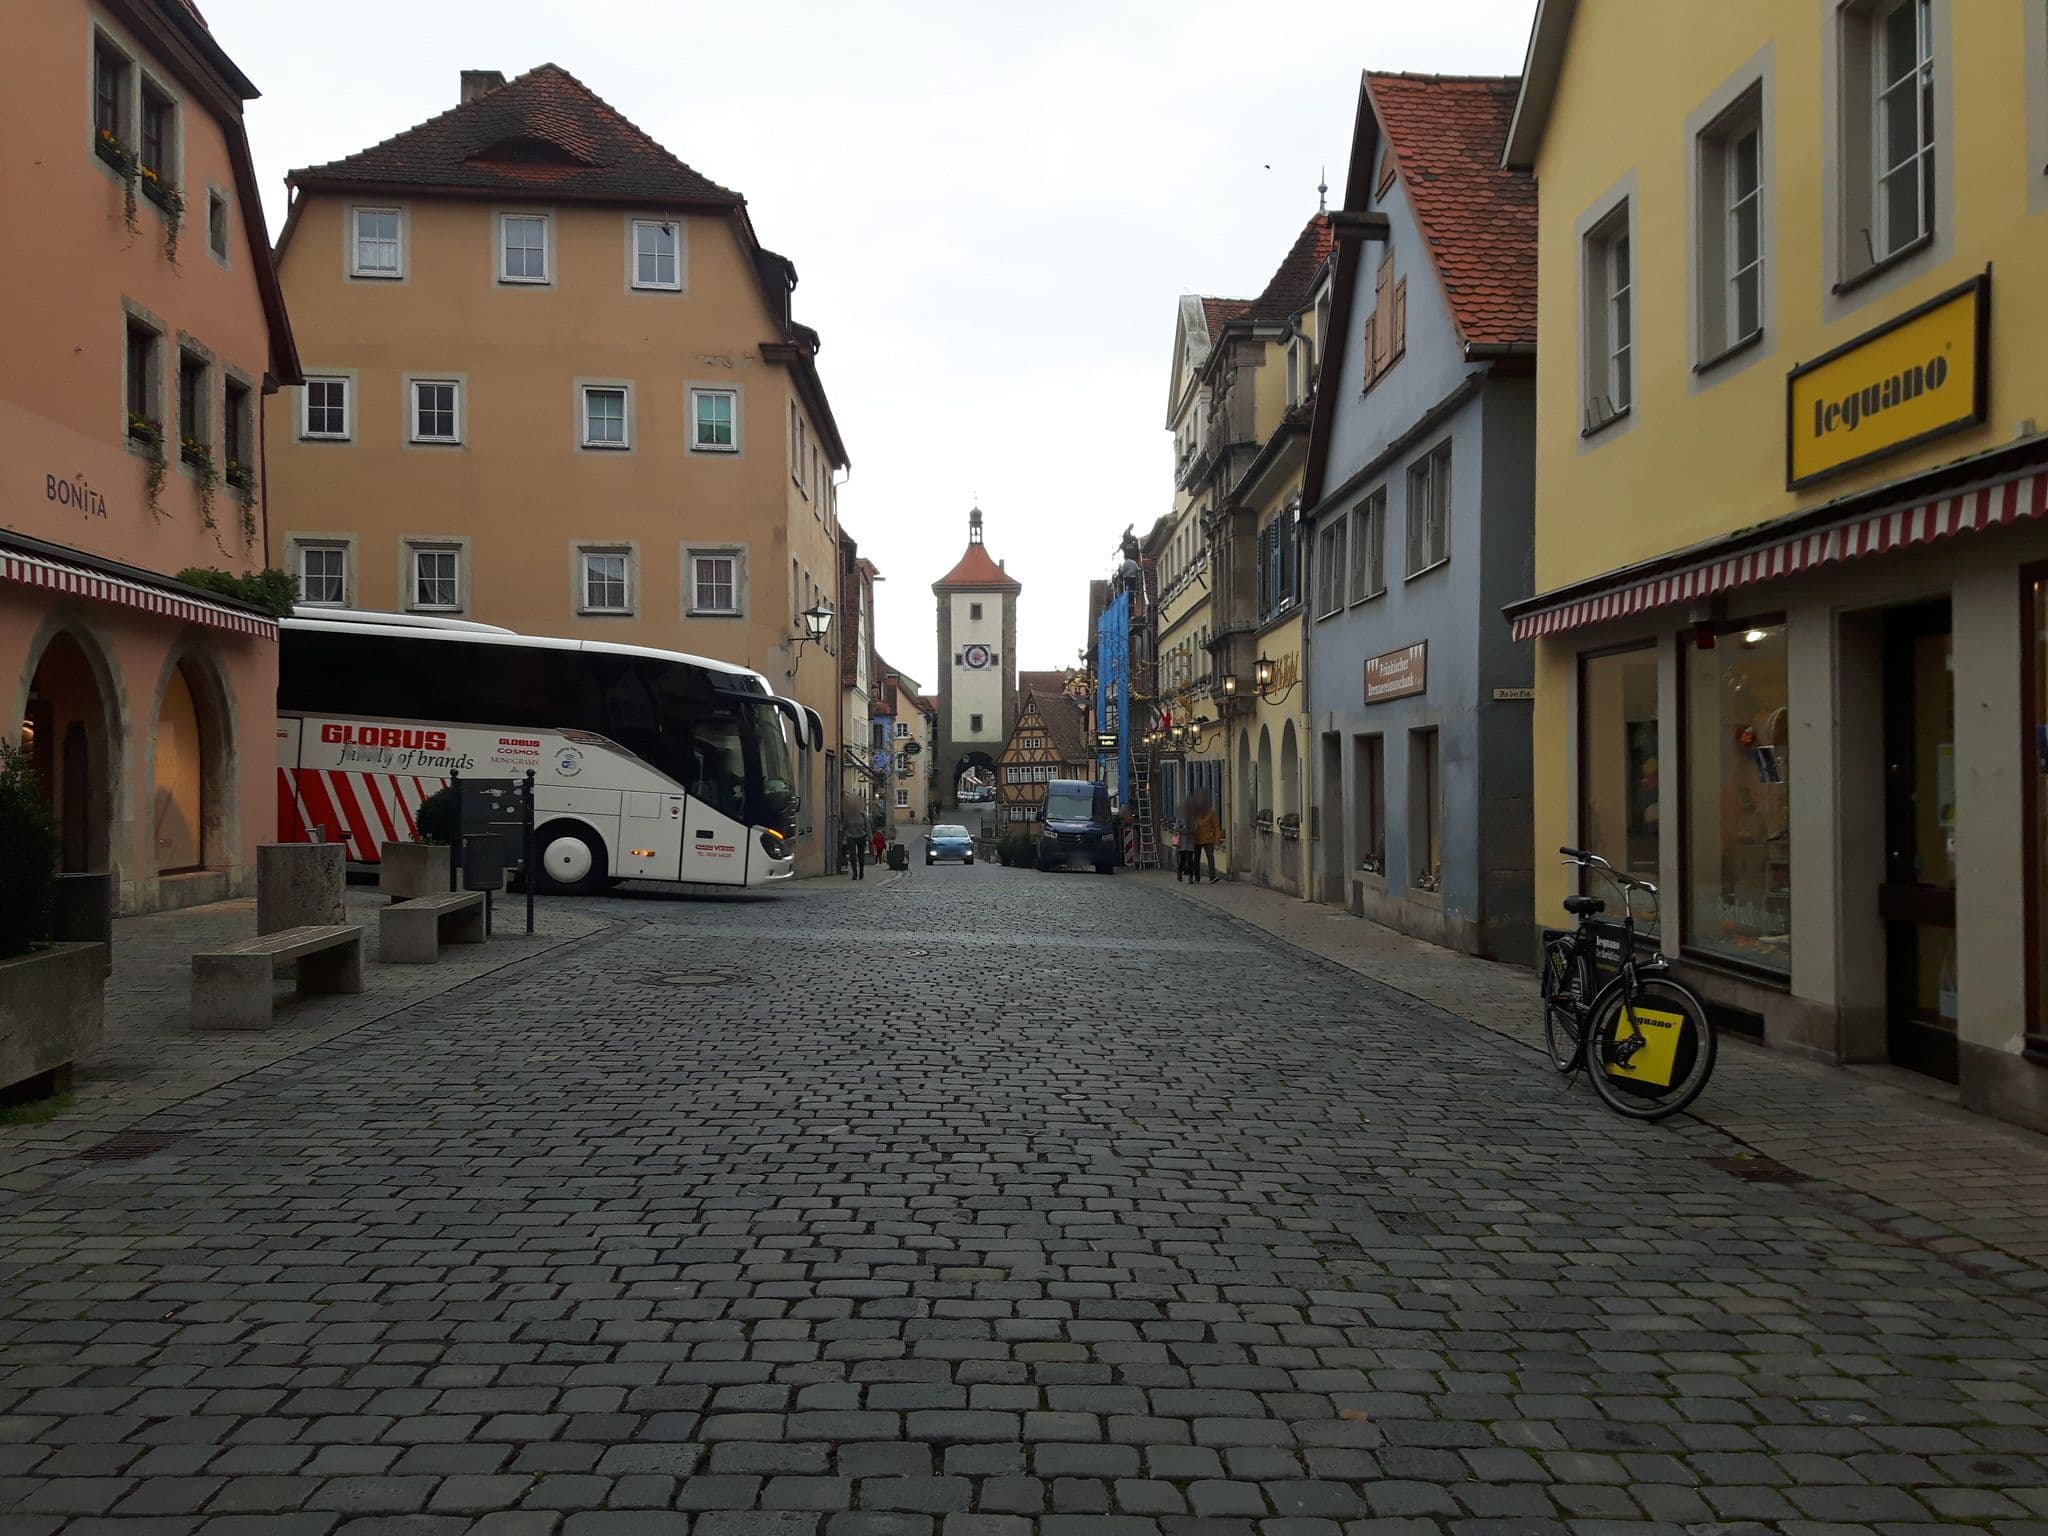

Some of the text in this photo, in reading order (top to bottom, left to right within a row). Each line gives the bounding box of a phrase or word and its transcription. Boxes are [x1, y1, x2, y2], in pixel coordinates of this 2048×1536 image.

[1815, 355, 1948, 438] leguano
[47, 473, 108, 521] BONITA
[320, 723, 447, 751] GLOBUS
[498, 738, 540, 748] GLOBUS
[397, 750, 417, 770] of
[417, 750, 475, 769] brands
[497, 747, 540, 756] COSMOS
[1633, 1015, 1673, 1029] guano
